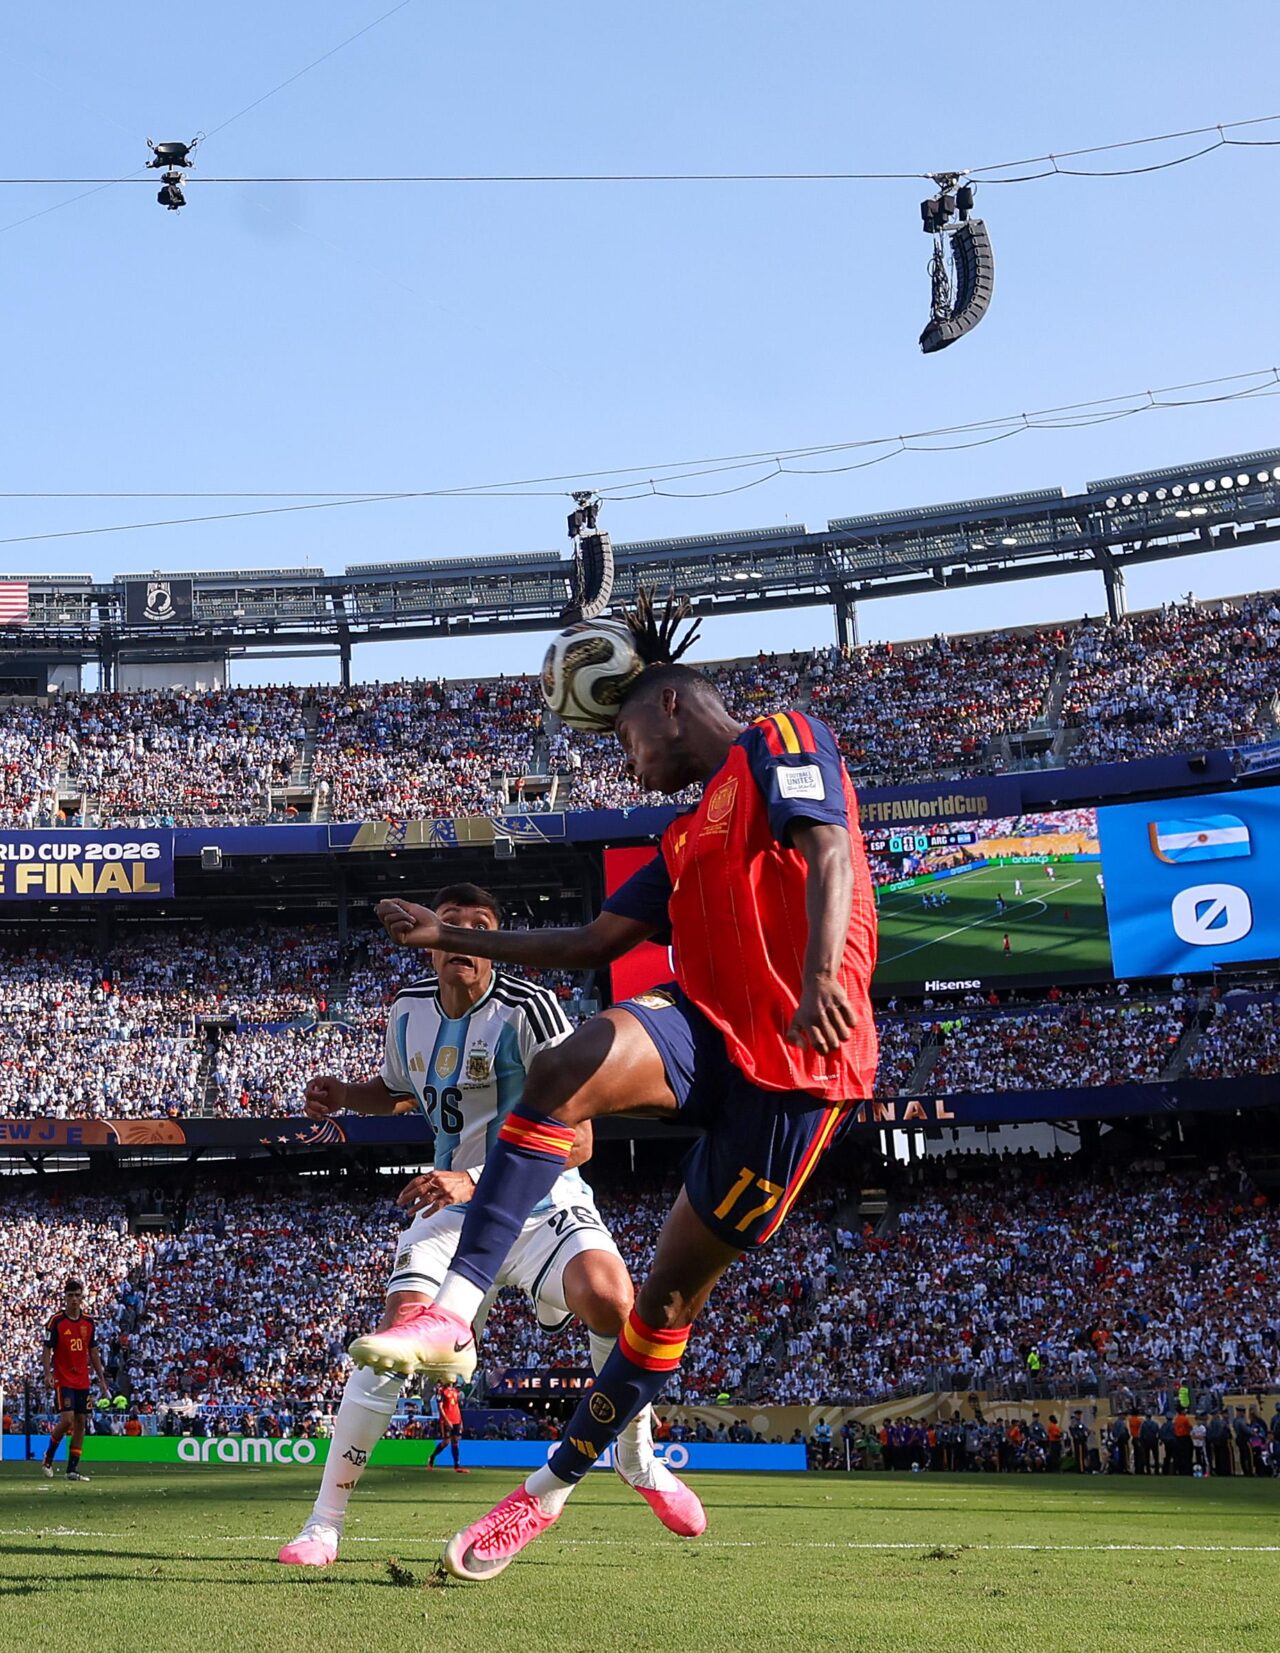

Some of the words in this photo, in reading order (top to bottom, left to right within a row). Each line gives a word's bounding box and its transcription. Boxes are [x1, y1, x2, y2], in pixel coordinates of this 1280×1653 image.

[786, 777, 814, 786] UNITES
[859, 795, 988, 823] #FIFAWorldCup
[38, 843, 81, 860] CUP
[84, 842, 161, 860] 2026
[870, 842, 885, 851] ESP
[931, 836, 948, 846] ARG
[16, 862, 161, 894] FINAL
[924, 980, 981, 992] Hisense
[423, 1086, 464, 1134] 26
[713, 1167, 785, 1232] 17
[548, 1206, 600, 1236] 26
[70, 1339, 83, 1351] 20
[505, 1378, 542, 1389] THE
[177, 1437, 316, 1464] aramco
